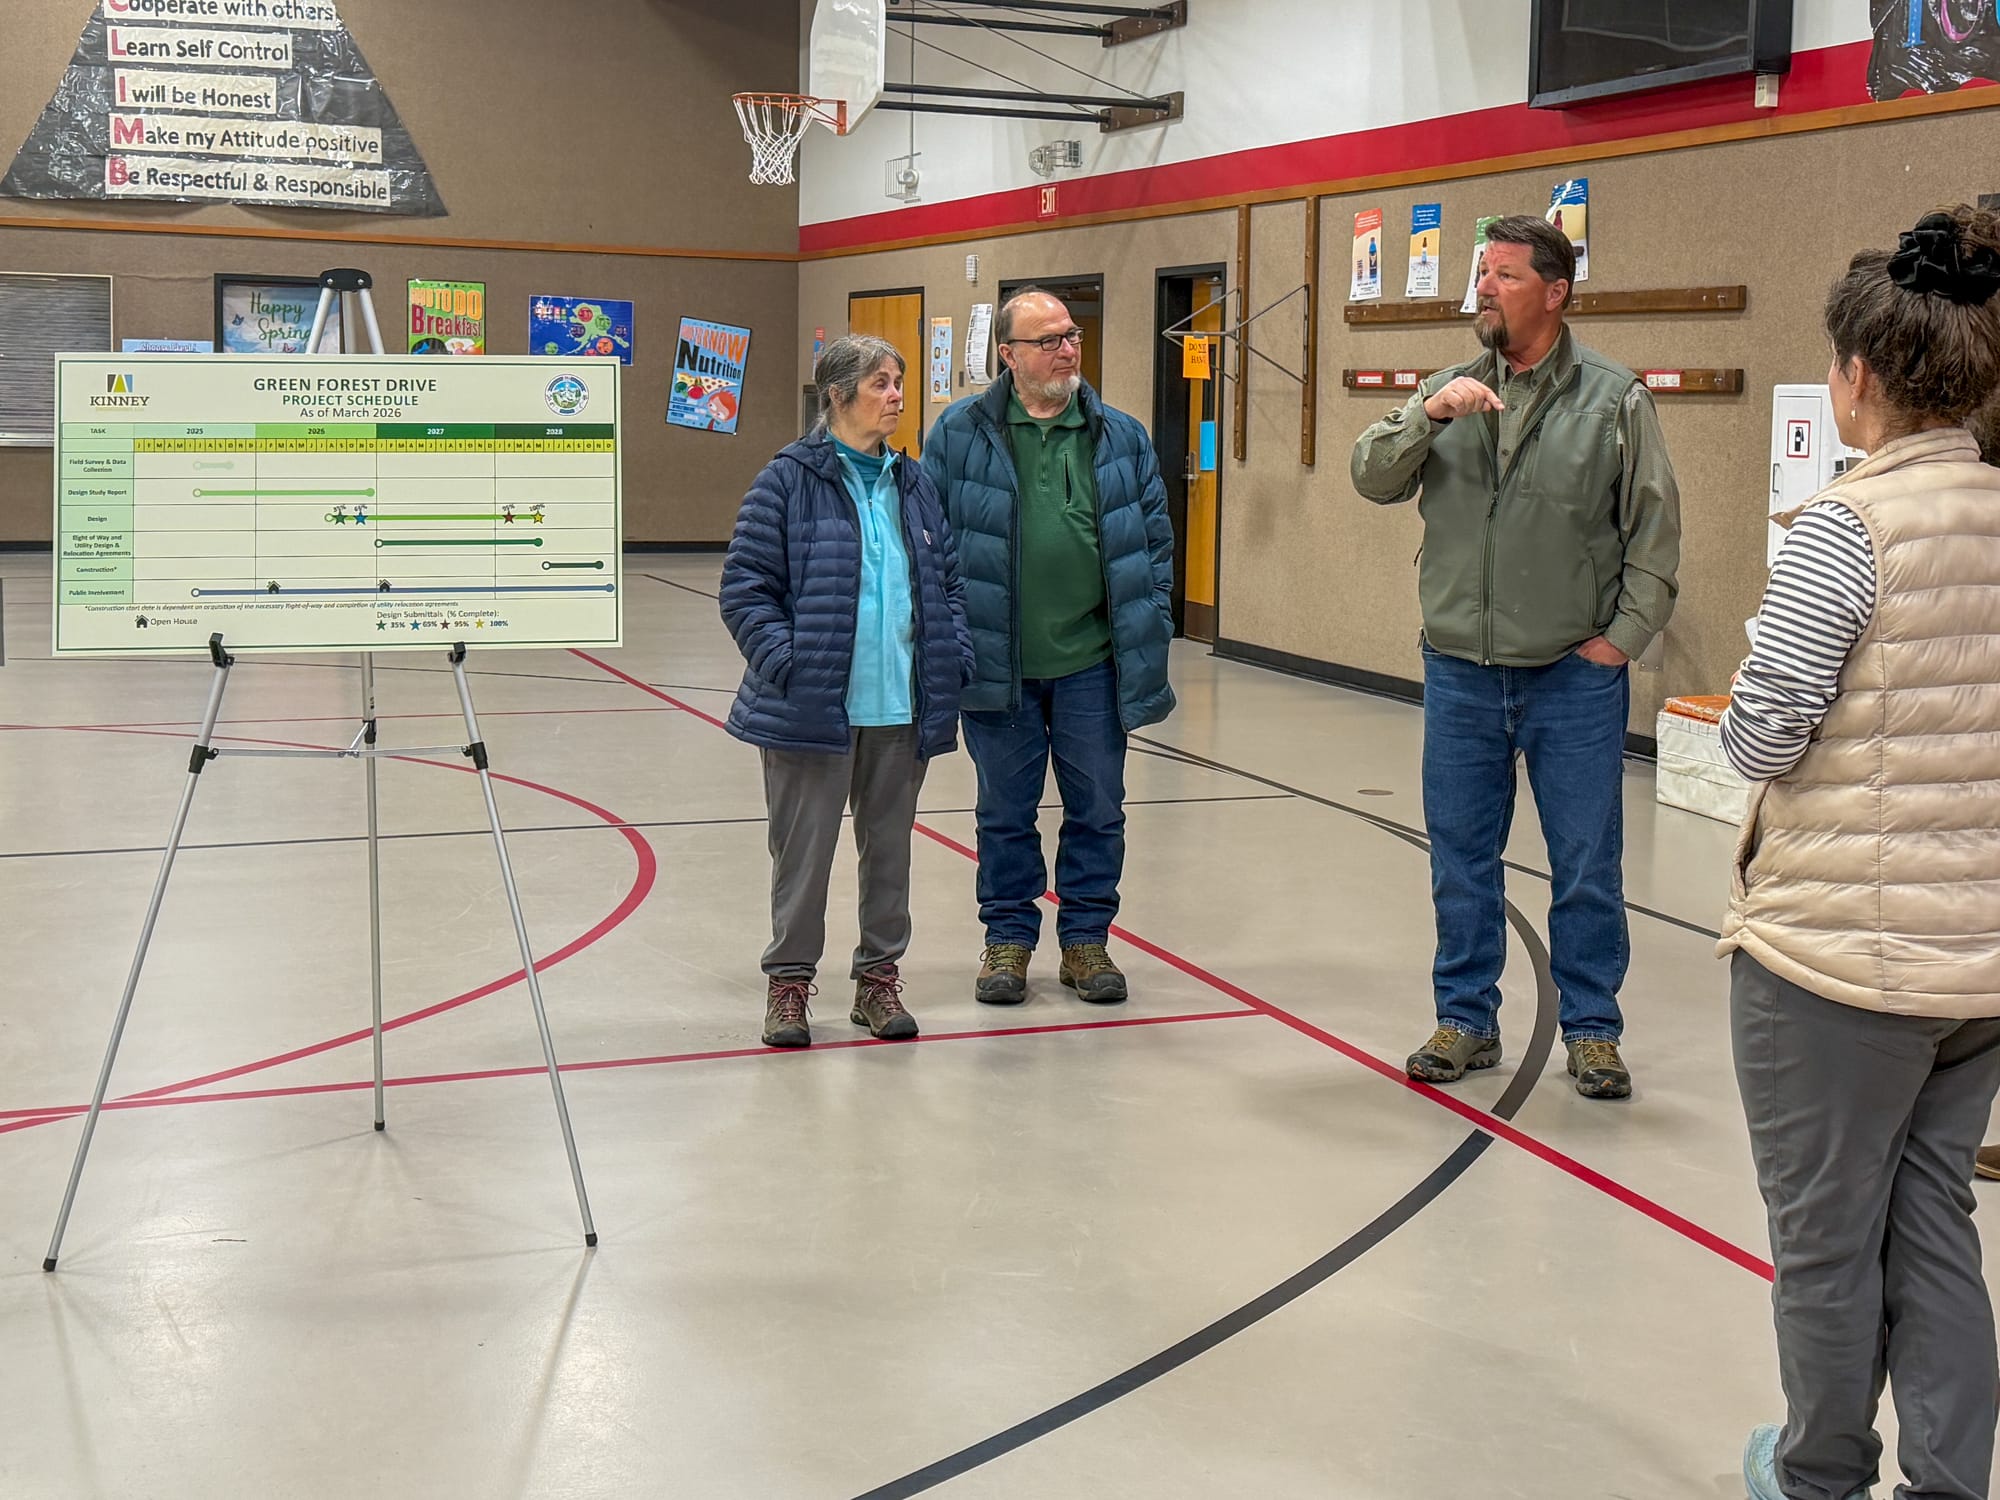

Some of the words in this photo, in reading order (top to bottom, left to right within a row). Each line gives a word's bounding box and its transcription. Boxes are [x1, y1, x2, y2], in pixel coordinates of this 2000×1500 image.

[224, 0, 267, 17] with
[272, 1, 334, 21] others
[111, 29, 170, 57] Learn
[176, 39, 213, 58] Self
[218, 41, 289, 61] Control
[119, 76, 126, 102] I
[131, 85, 166, 103] will
[172, 86, 196, 104] be
[202, 88, 271, 109] Honest
[113, 117, 180, 146] Make
[186, 131, 216, 150] my
[219, 130, 300, 149] Attitude
[305, 134, 379, 155] positive
[108, 157, 140, 186] Be
[147, 167, 247, 191] Respectful
[253, 173, 269, 192] &
[275, 175, 387, 200] Responsible
[1042, 187, 1056, 214] EXIT
[248, 291, 305, 324] Happy
[411, 304, 481, 336] Breakfast
[435, 289, 452, 313] TO
[454, 290, 482, 321] DO
[258, 317, 312, 350] Spring
[676, 338, 741, 380] Nutrition
[254, 378, 311, 391] GREEN
[317, 379, 380, 391] FOREST
[387, 379, 437, 391] DRIVE
[283, 395, 343, 405] PROJECT
[347, 395, 419, 406] SCHEDULE
[90, 396, 150, 406] KINNEY
[300, 408, 314, 417] As
[317, 408, 330, 417] of
[333, 408, 369, 417] March
[373, 408, 402, 417] 2026
[150, 618, 171, 626] Open
[376, 611, 402, 619] Design
[404, 610, 443, 618] Submittals
[458, 610, 500, 618] Complete):
